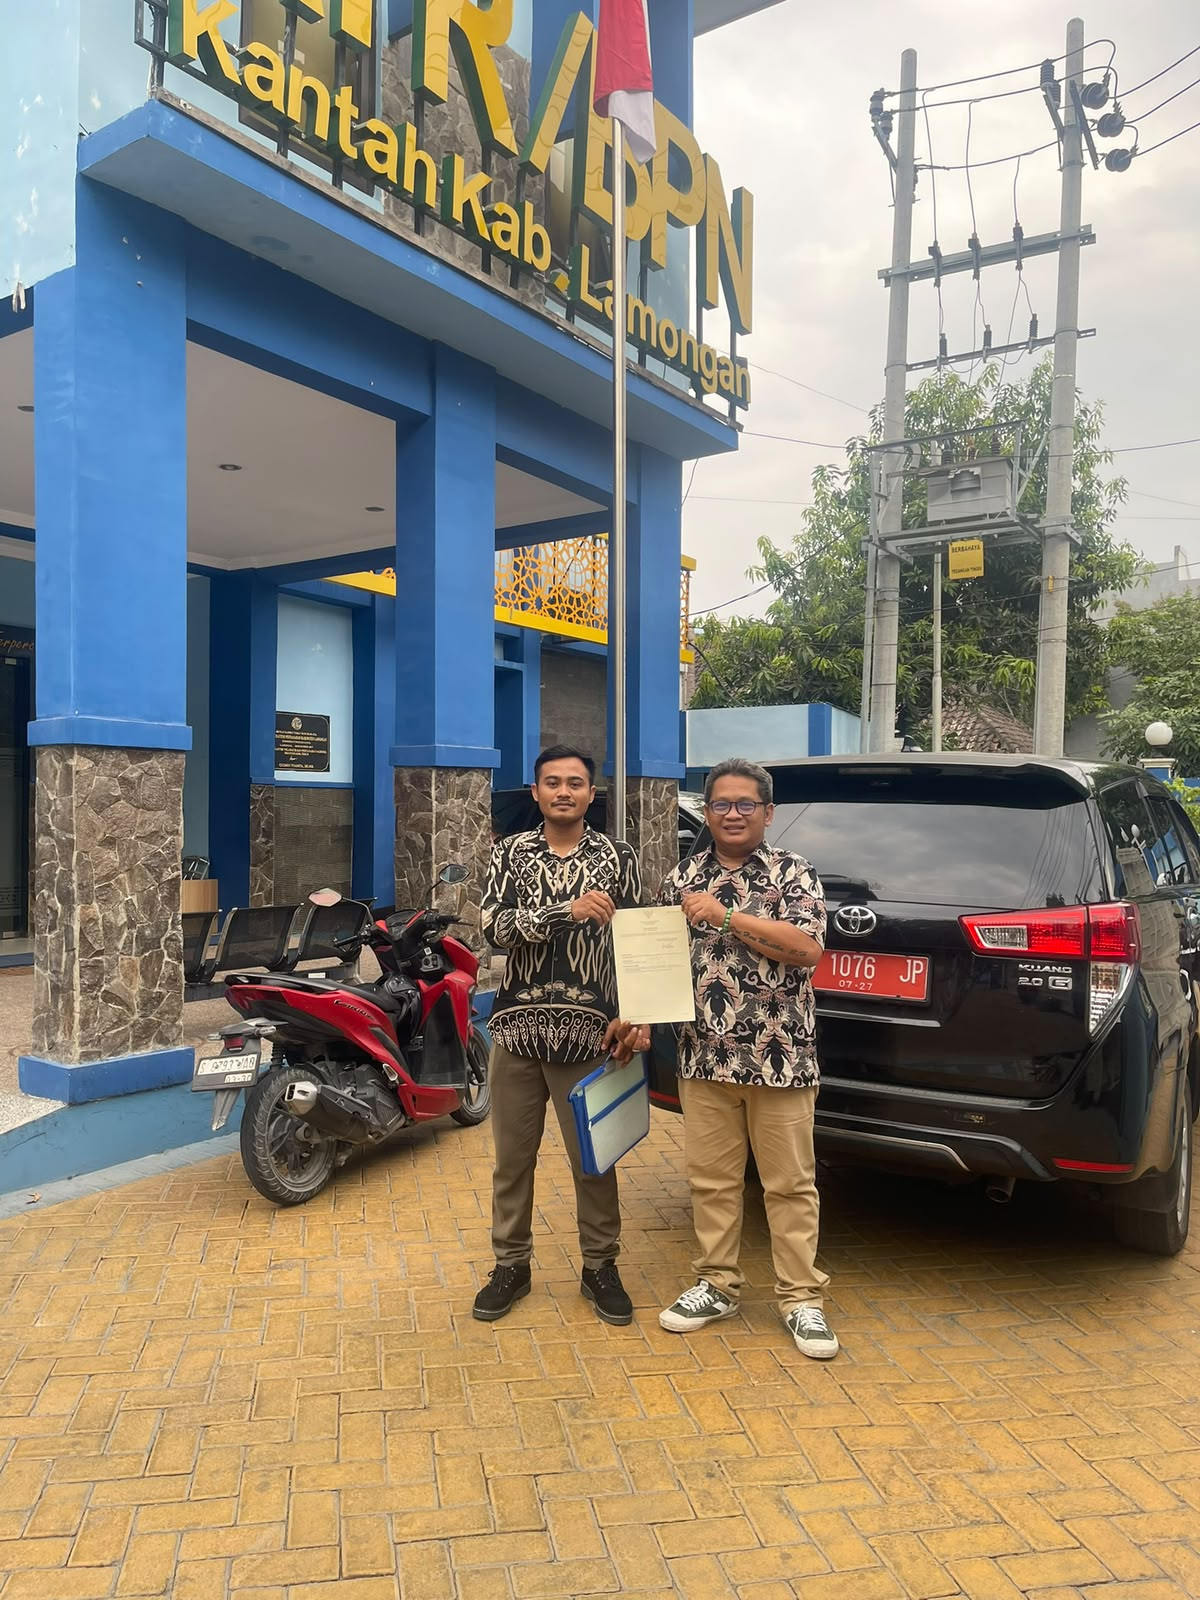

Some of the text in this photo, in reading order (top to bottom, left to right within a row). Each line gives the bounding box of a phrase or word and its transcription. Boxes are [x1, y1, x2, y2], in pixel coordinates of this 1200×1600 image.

[169, 0, 438, 210] Kantah
[831, 953, 924, 985] 1076 JP
